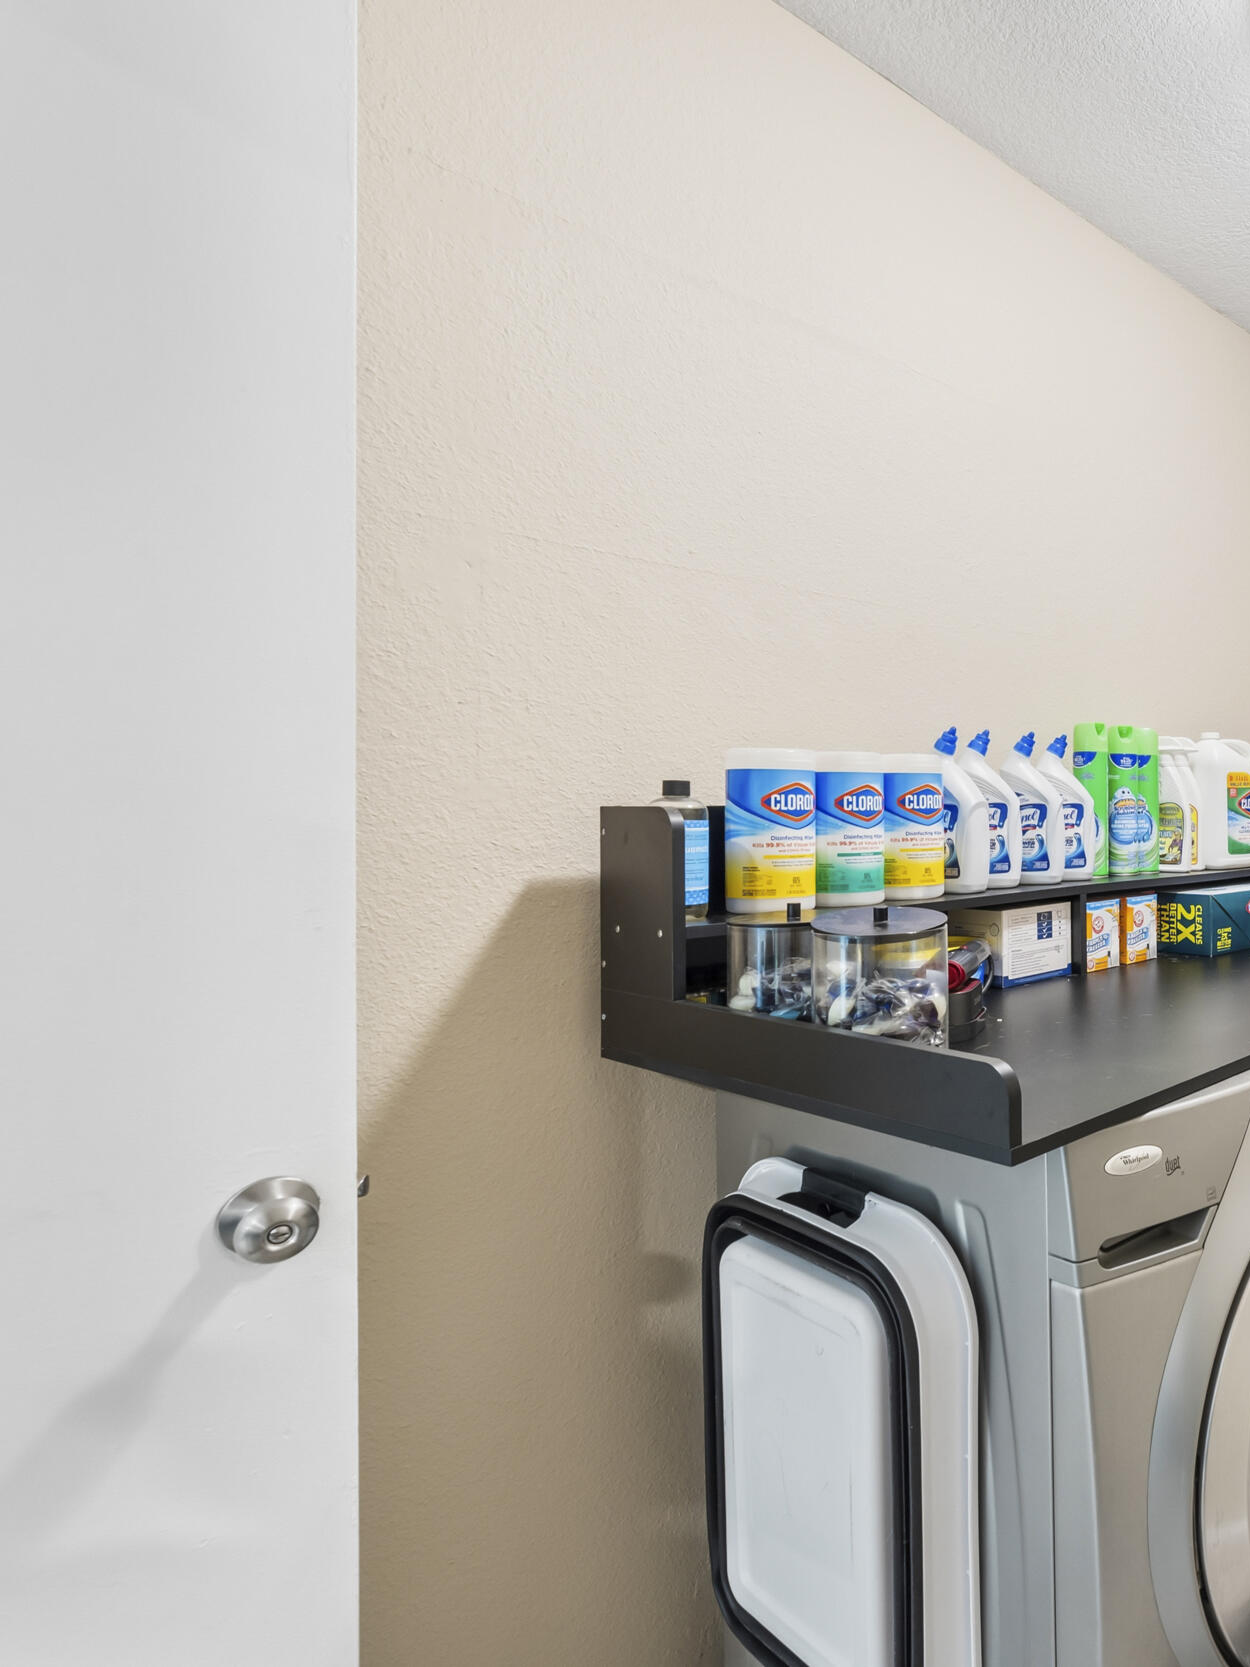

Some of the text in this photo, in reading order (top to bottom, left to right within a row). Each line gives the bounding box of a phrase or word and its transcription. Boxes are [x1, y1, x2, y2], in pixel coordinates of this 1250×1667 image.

[1161, 903, 1169, 943] THAN
[1177, 903, 1196, 944] 2X
[1122, 1153, 1149, 1166] Whirlpool
